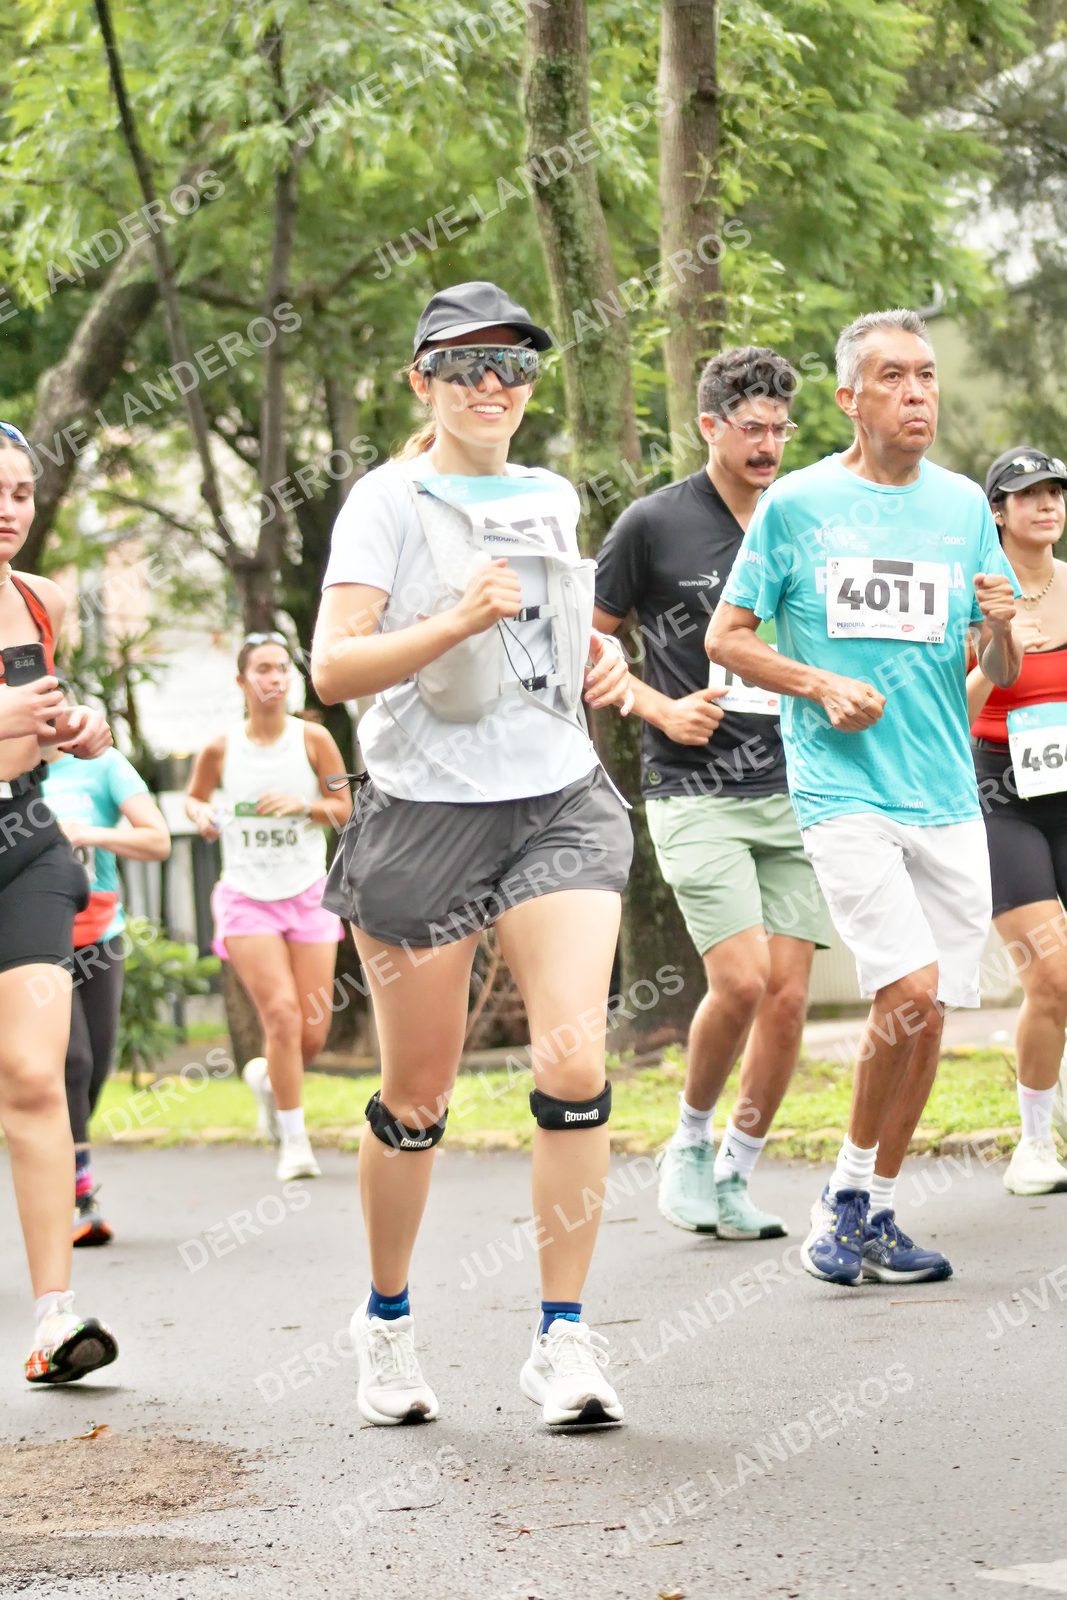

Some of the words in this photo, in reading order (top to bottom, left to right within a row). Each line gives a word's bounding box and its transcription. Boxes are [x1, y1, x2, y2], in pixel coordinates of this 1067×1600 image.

[837, 577, 935, 616] 4011
[1021, 744, 1067, 772] 46
[242, 829, 298, 848] 1950
[565, 1109, 599, 1122] GOUNOD
